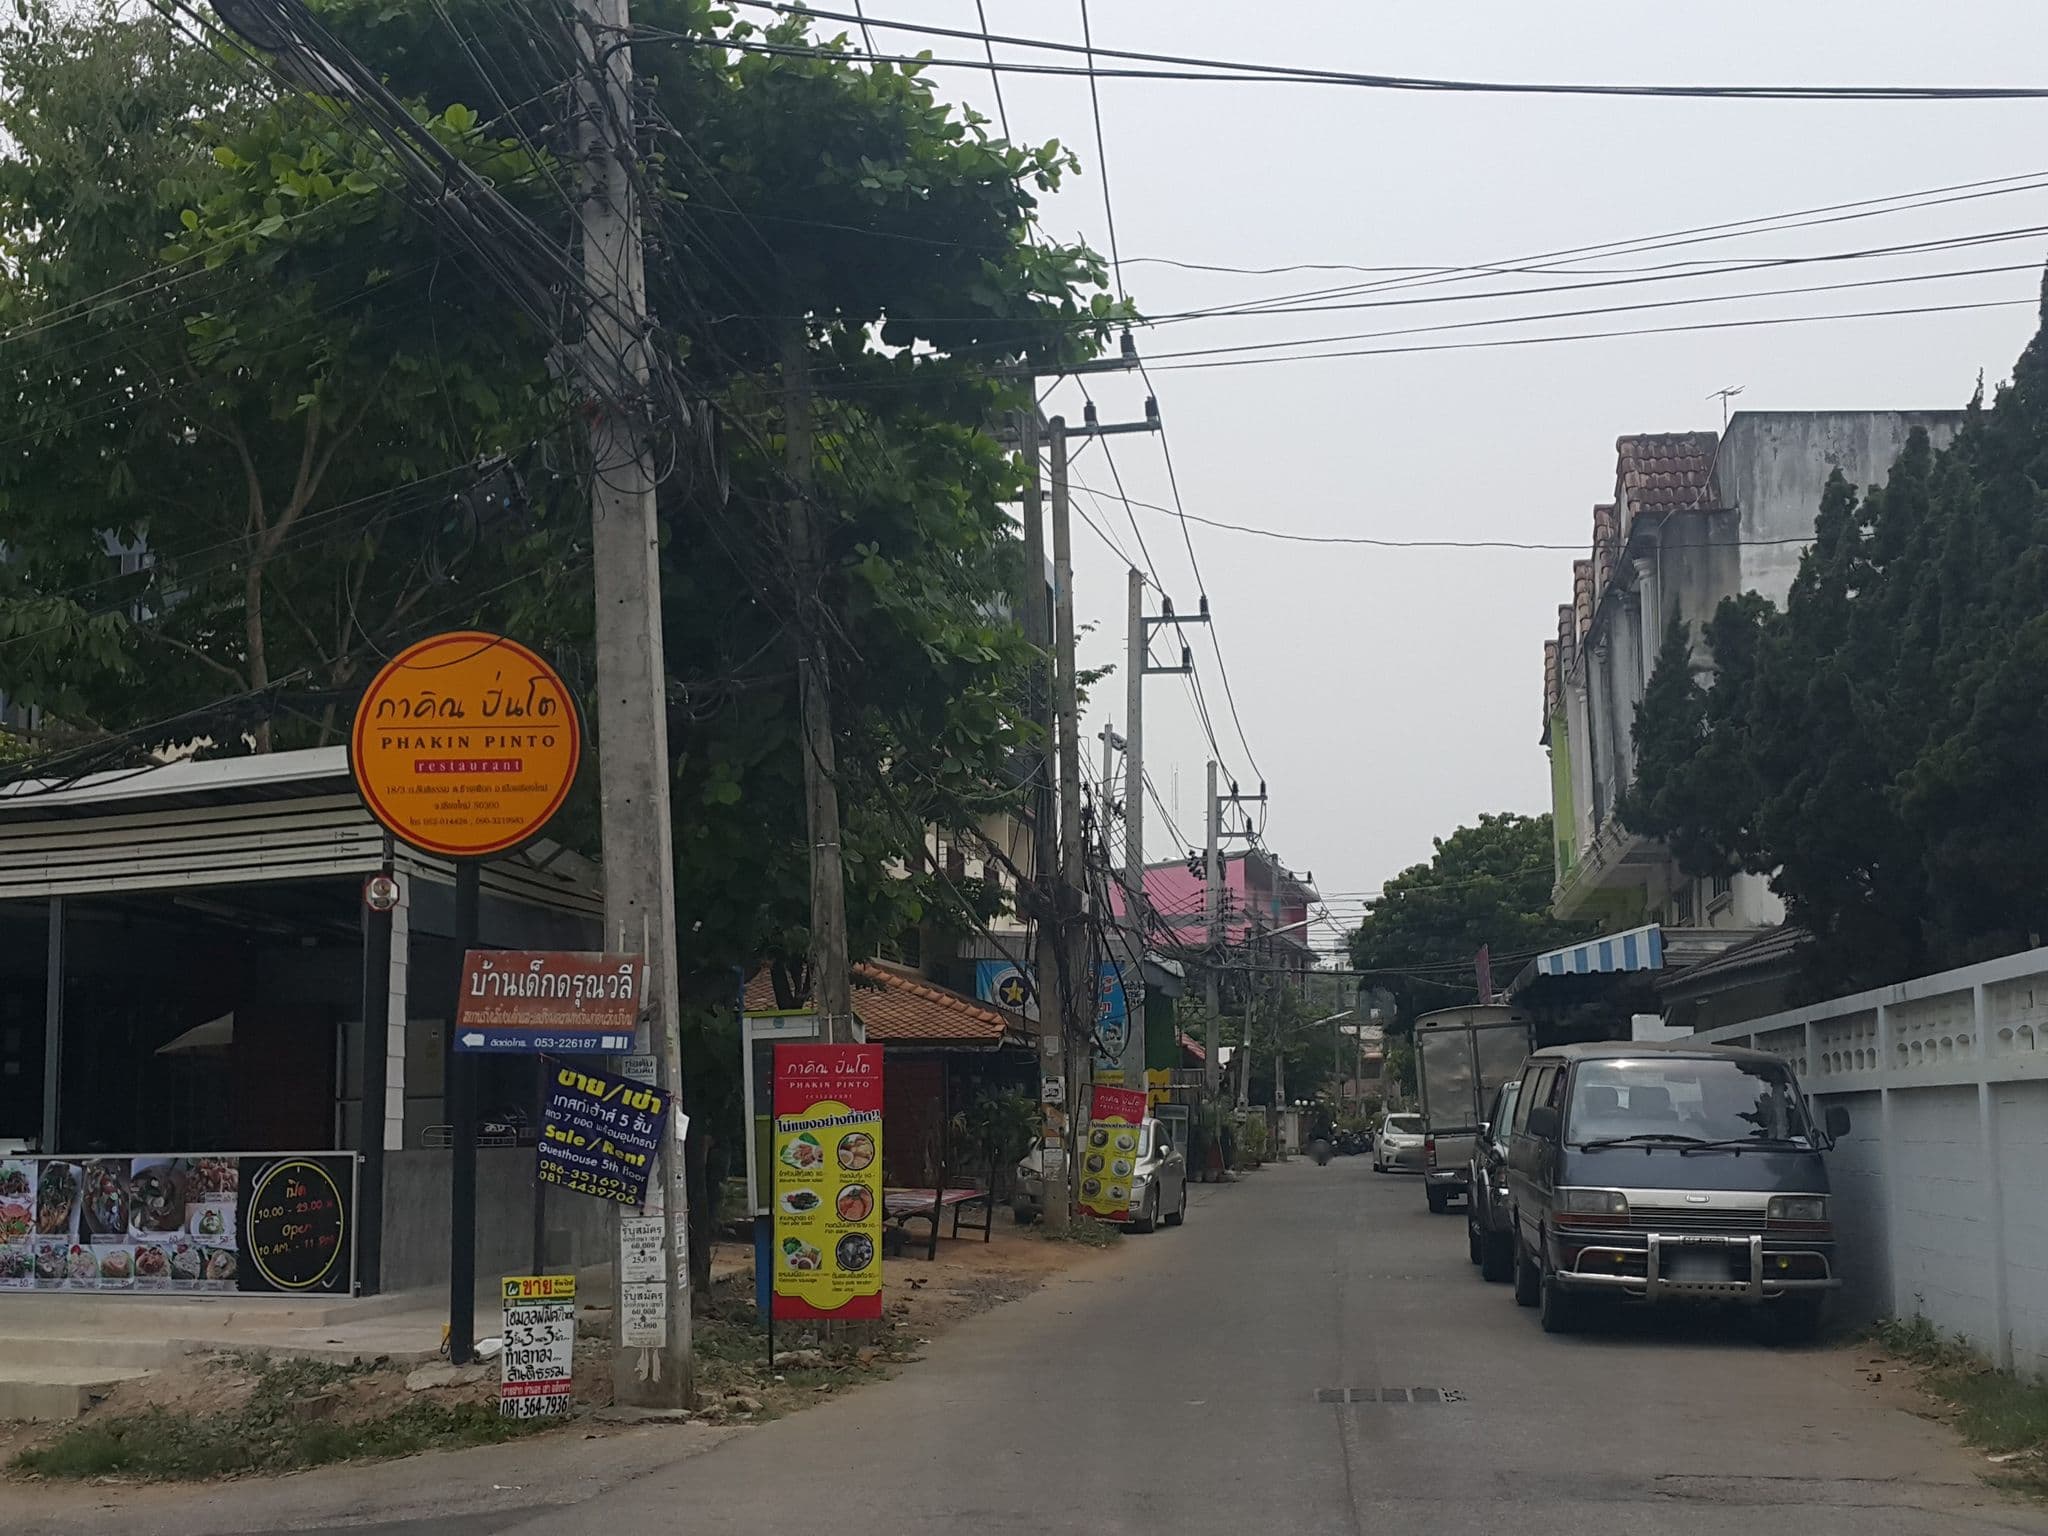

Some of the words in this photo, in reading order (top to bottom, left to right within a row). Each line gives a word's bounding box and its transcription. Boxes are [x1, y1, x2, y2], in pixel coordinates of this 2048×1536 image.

[376, 691, 465, 720] ภาคิณ
[481, 671, 557, 718] ปิ่นโต
[381, 735, 471, 750] PHAKIN
[485, 734, 556, 749] PINTO
[417, 760, 521, 773] restaurant
[470, 959, 634, 1008] บ้านเด็กดรุณวลี
[534, 1037, 598, 1049] 053-226187
[789, 1081, 831, 1089] PHAKIN
[836, 1080, 870, 1089] PINTO
[618, 1111, 629, 1128] 5
[633, 1113, 653, 1135] ชั้น
[777, 1108, 880, 1132] ไม่แพงอย่างที่คิด!!
[537, 1141, 599, 1168] Guesthouse
[600, 1156, 620, 1174] 5th
[538, 1169, 636, 1205] 081-4439706
[539, 1159, 639, 1196] 086-3516913
[258, 1206, 284, 1220] 10.00
[622, 1223, 663, 1236] รับสมัคร
[522, 1279, 553, 1297] ขาย
[623, 1288, 664, 1301] รับสมัคร
[502, 1395, 568, 1417] 081-564-7936
